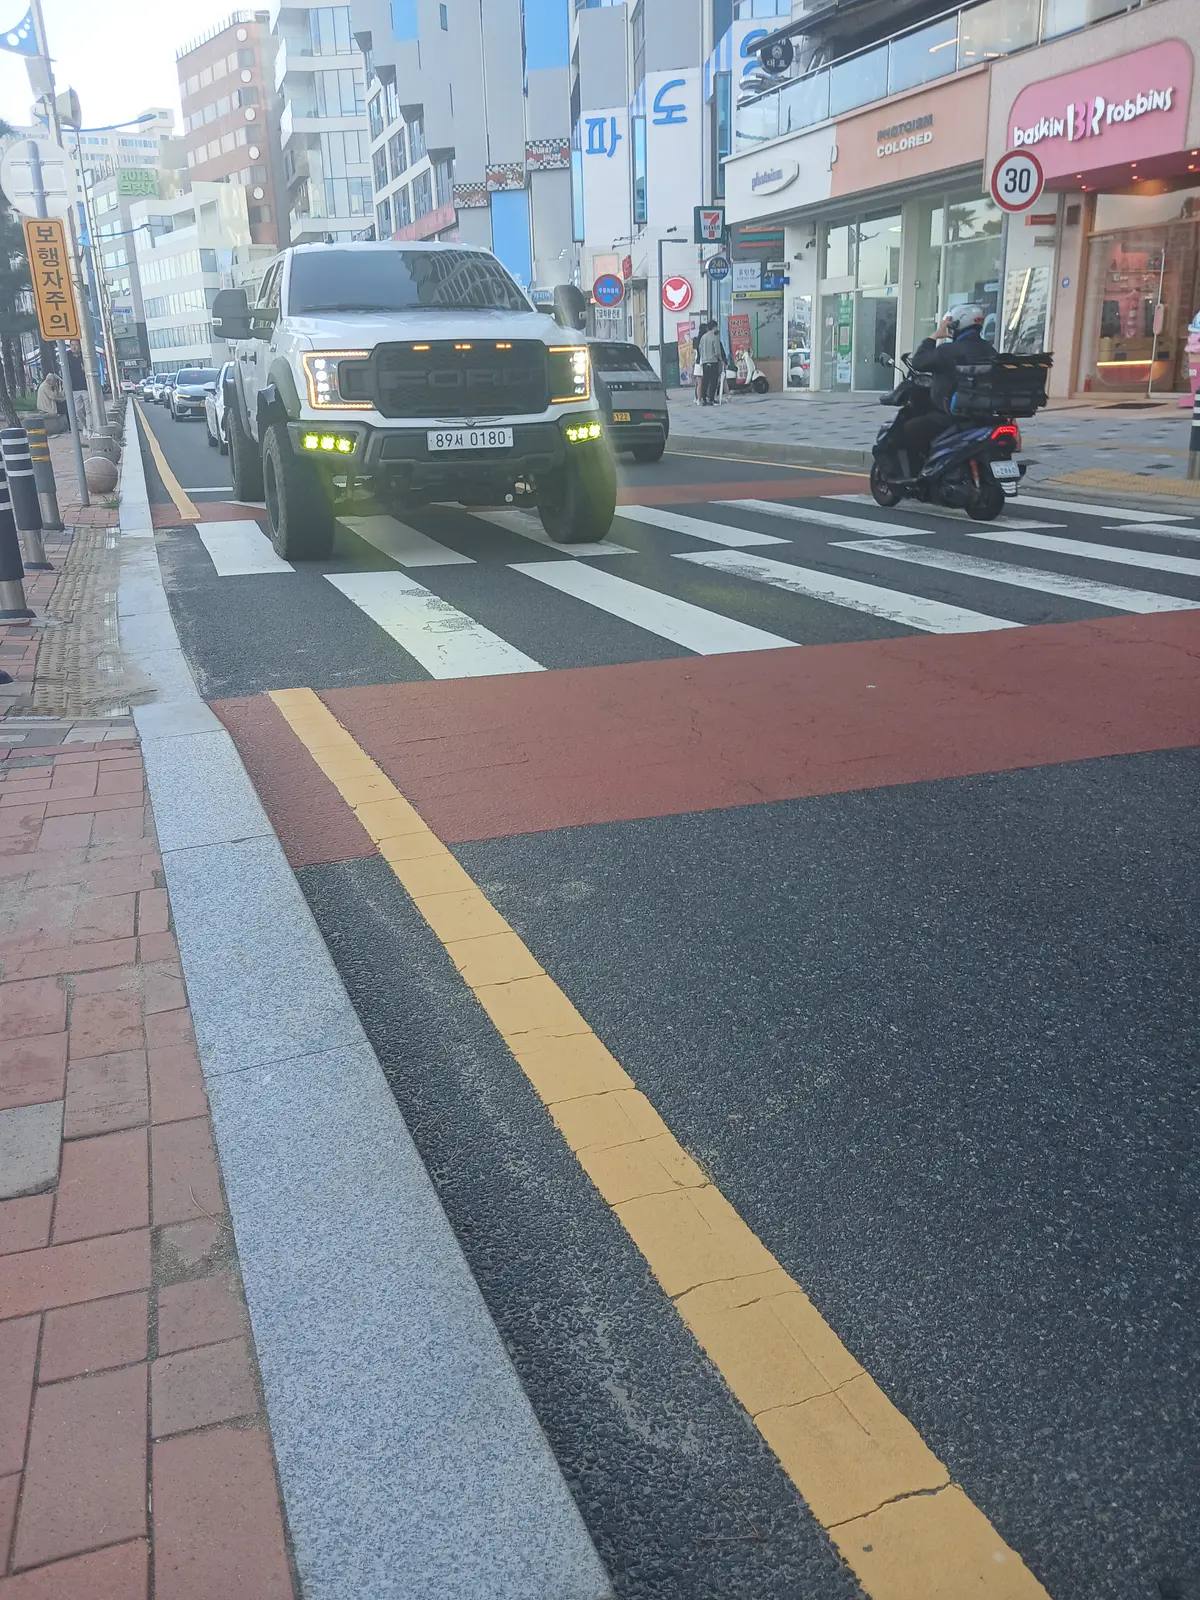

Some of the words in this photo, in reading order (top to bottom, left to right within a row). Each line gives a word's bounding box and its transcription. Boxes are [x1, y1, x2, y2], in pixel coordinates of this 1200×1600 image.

[877, 131, 933, 157] COLORED
[120, 171, 154, 182] HOTEL
[1004, 168, 1031, 194] 30
[436, 432, 464, 448] 89서
[470, 430, 507, 446] 0180
